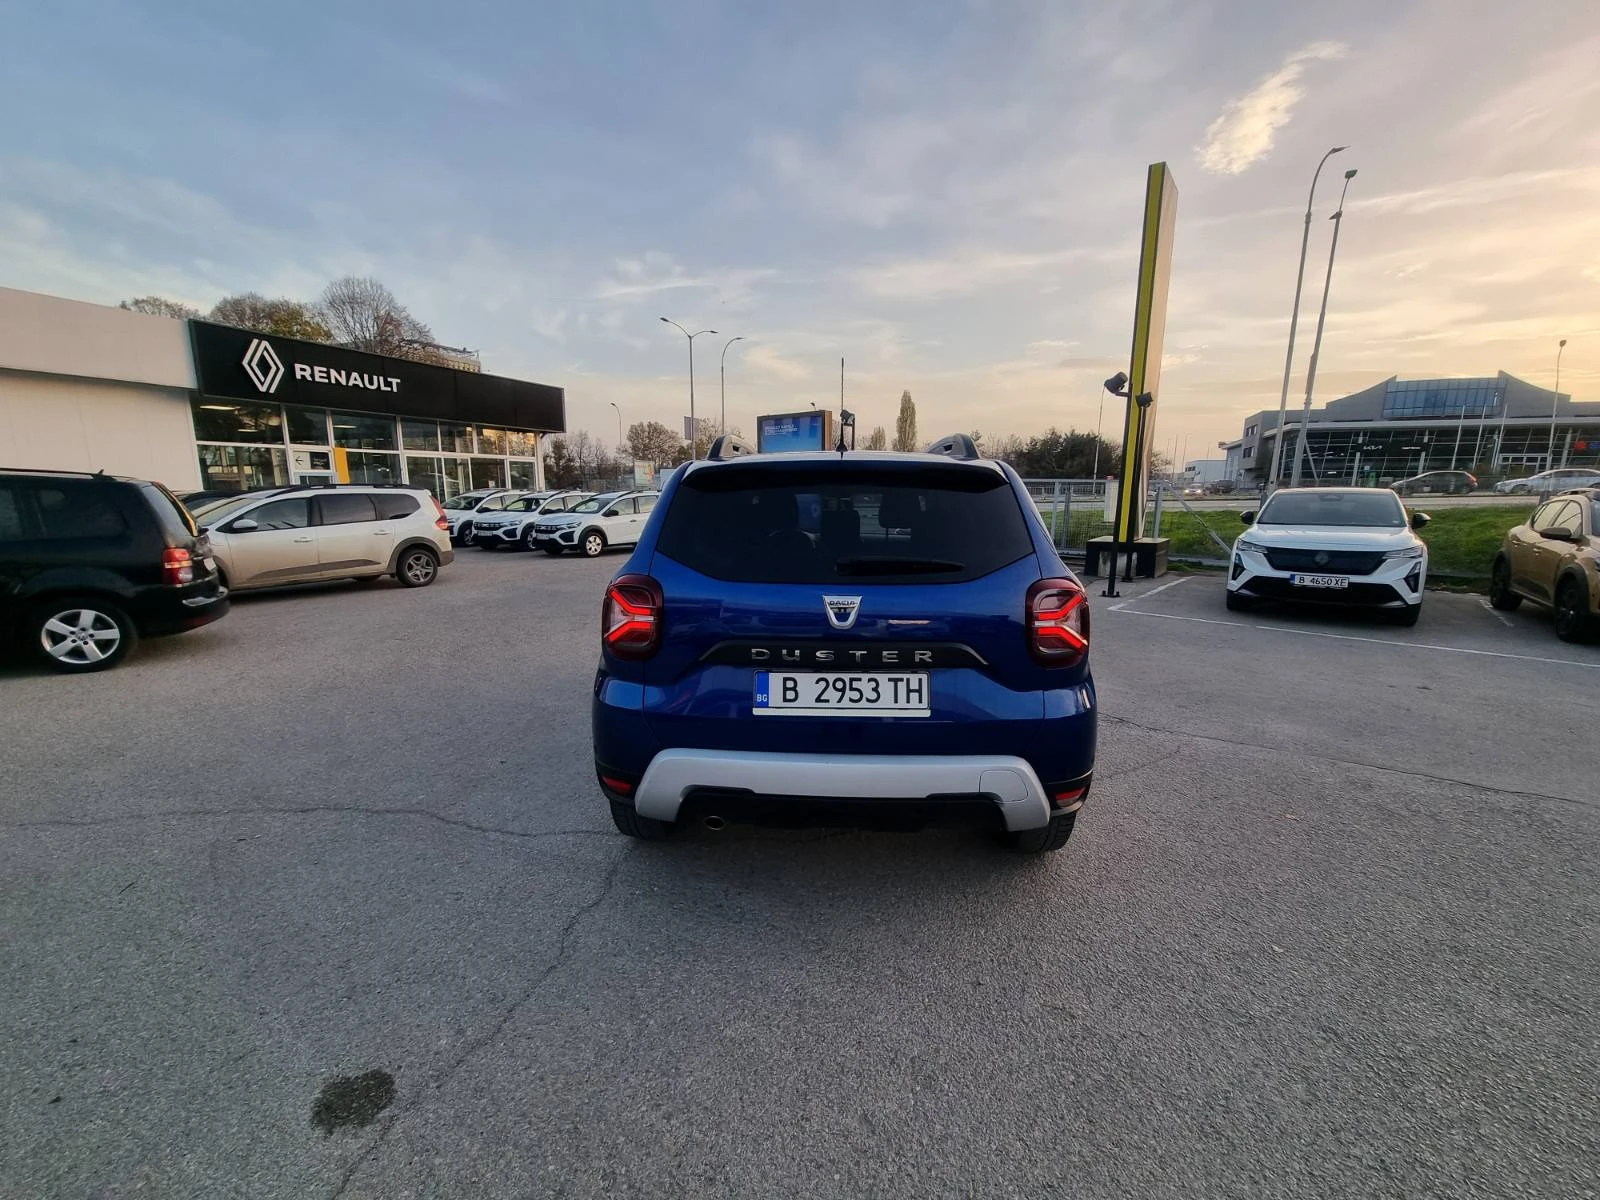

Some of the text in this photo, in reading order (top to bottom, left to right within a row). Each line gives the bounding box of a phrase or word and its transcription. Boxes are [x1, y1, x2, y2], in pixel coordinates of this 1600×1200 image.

[294, 362, 401, 393] RENAULT
[1298, 576, 1347, 587] B 4650 XE
[751, 648, 933, 663] DUSTER
[756, 694, 768, 702] BG
[782, 676, 923, 705] B 2953 TH
